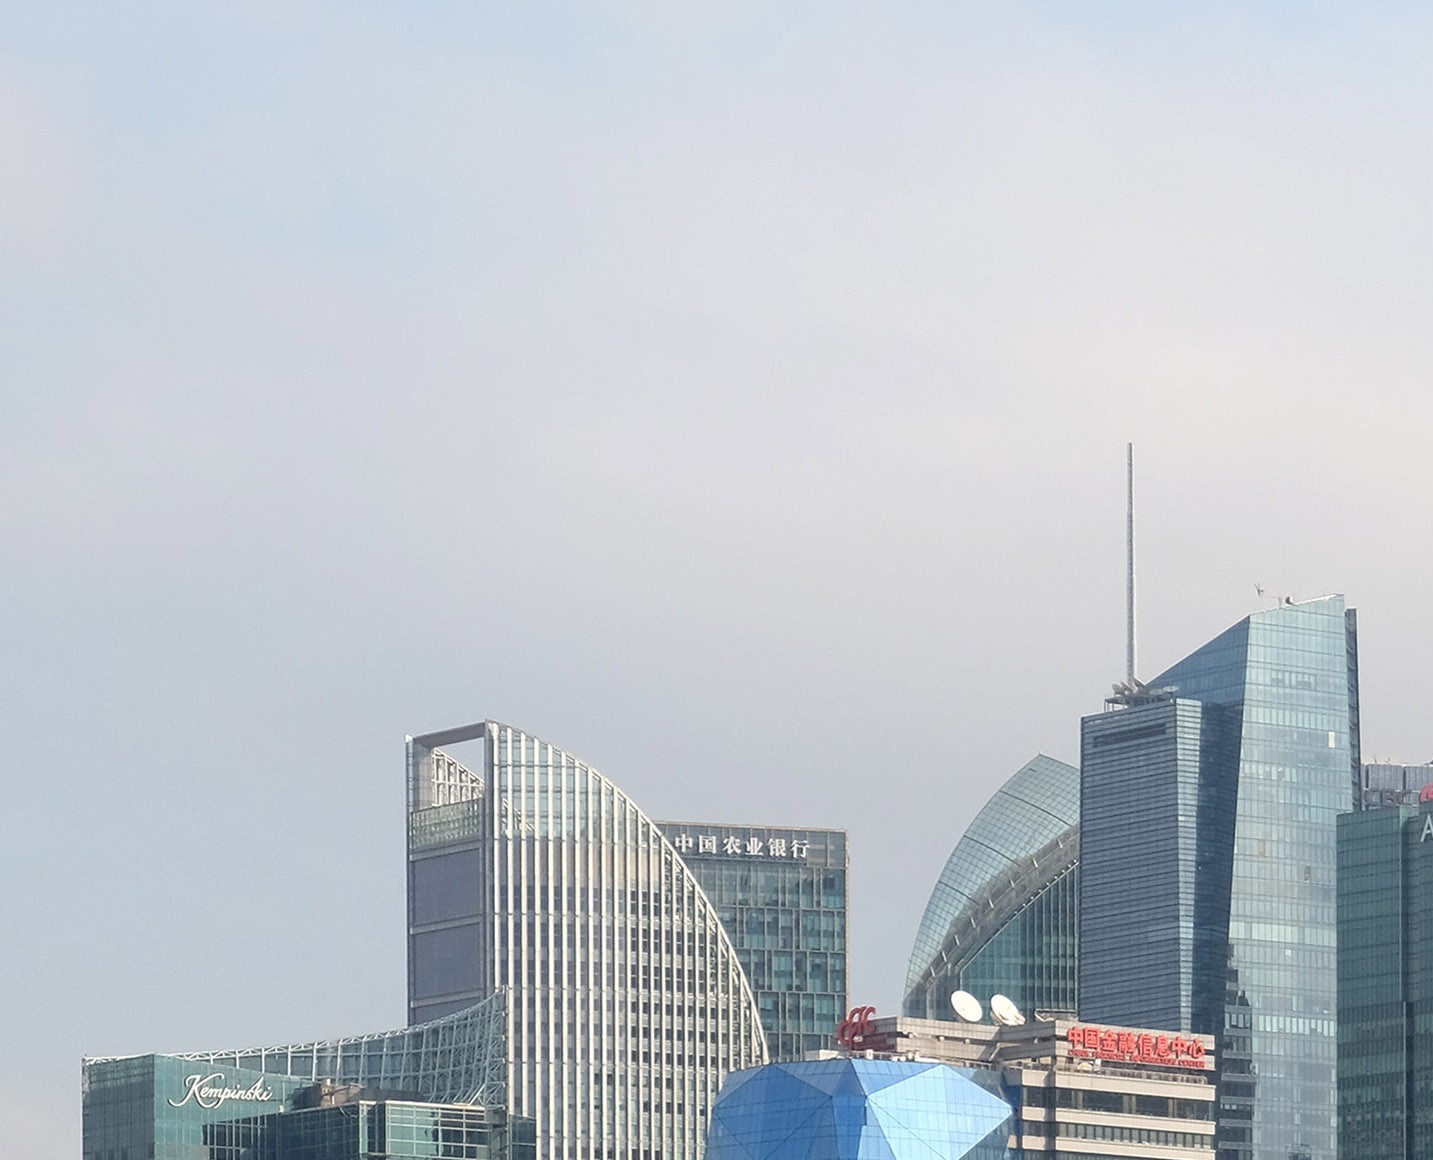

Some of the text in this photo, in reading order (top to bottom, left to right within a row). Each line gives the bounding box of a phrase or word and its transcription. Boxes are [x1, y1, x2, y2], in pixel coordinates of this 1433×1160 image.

[675, 833, 810, 858] 中国农业银行
[1068, 1027, 1206, 1059] 中国金融信息中心
[168, 1073, 273, 1109] Kempinski
